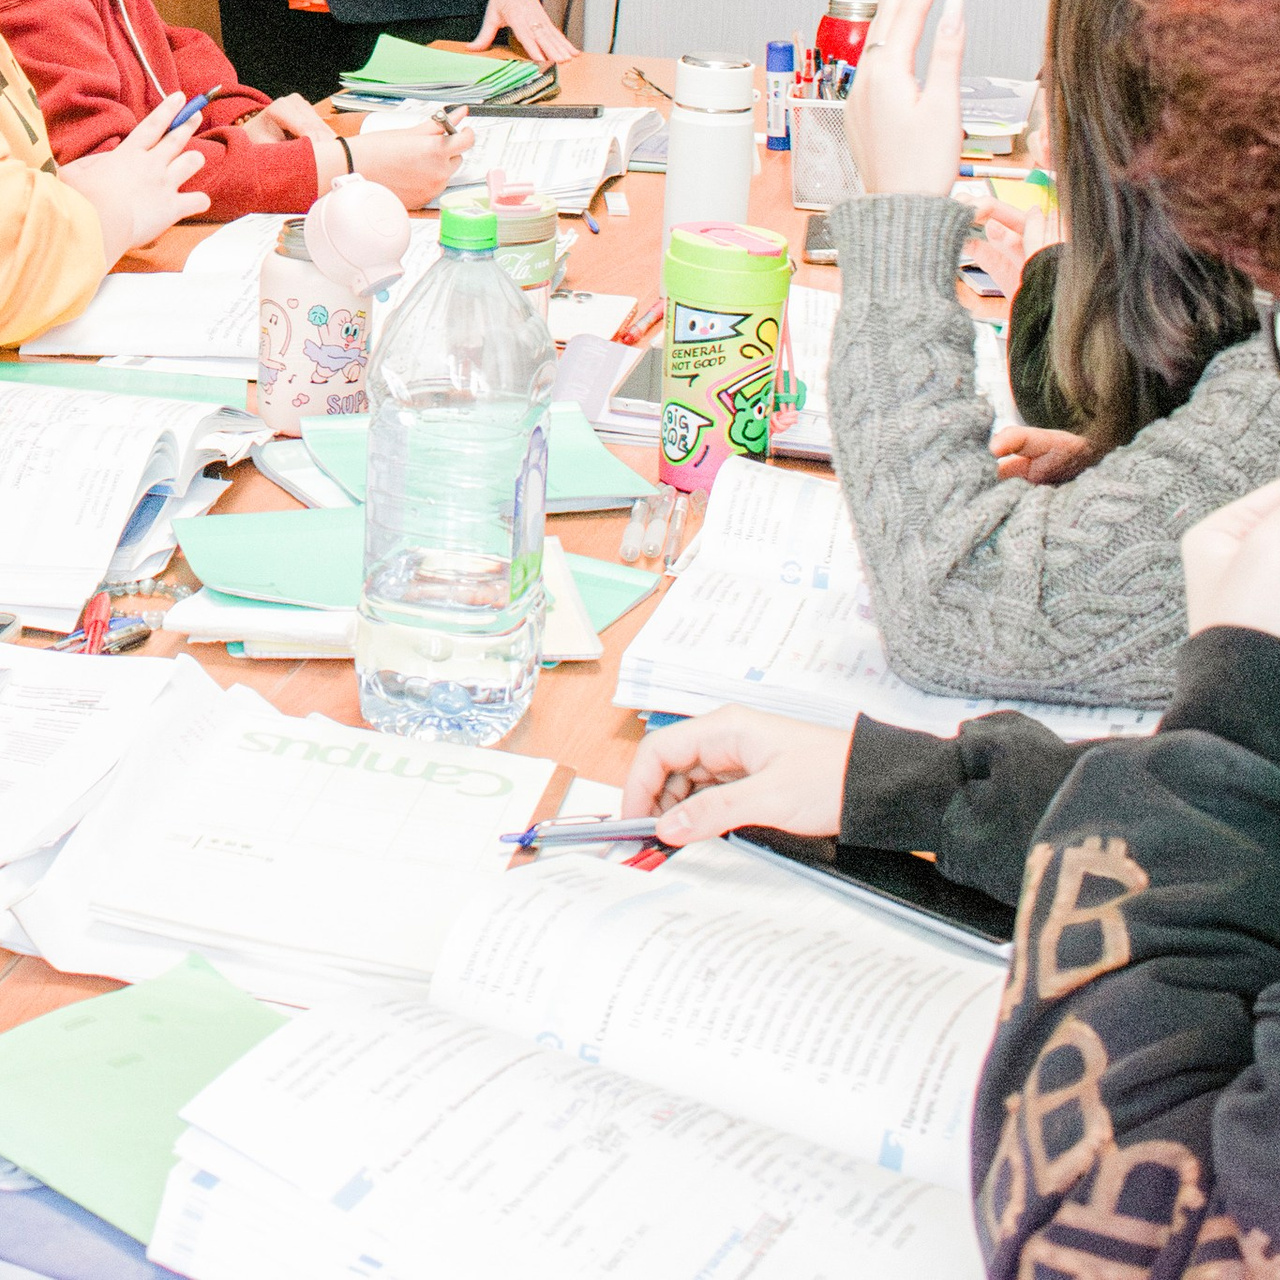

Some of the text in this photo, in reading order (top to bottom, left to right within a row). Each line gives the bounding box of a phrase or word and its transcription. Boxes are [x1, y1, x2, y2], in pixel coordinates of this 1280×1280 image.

[672, 344, 725, 359] GENERAL
[672, 356, 726, 371] NOT GOOD
[238, 731, 514, 798] Campus
